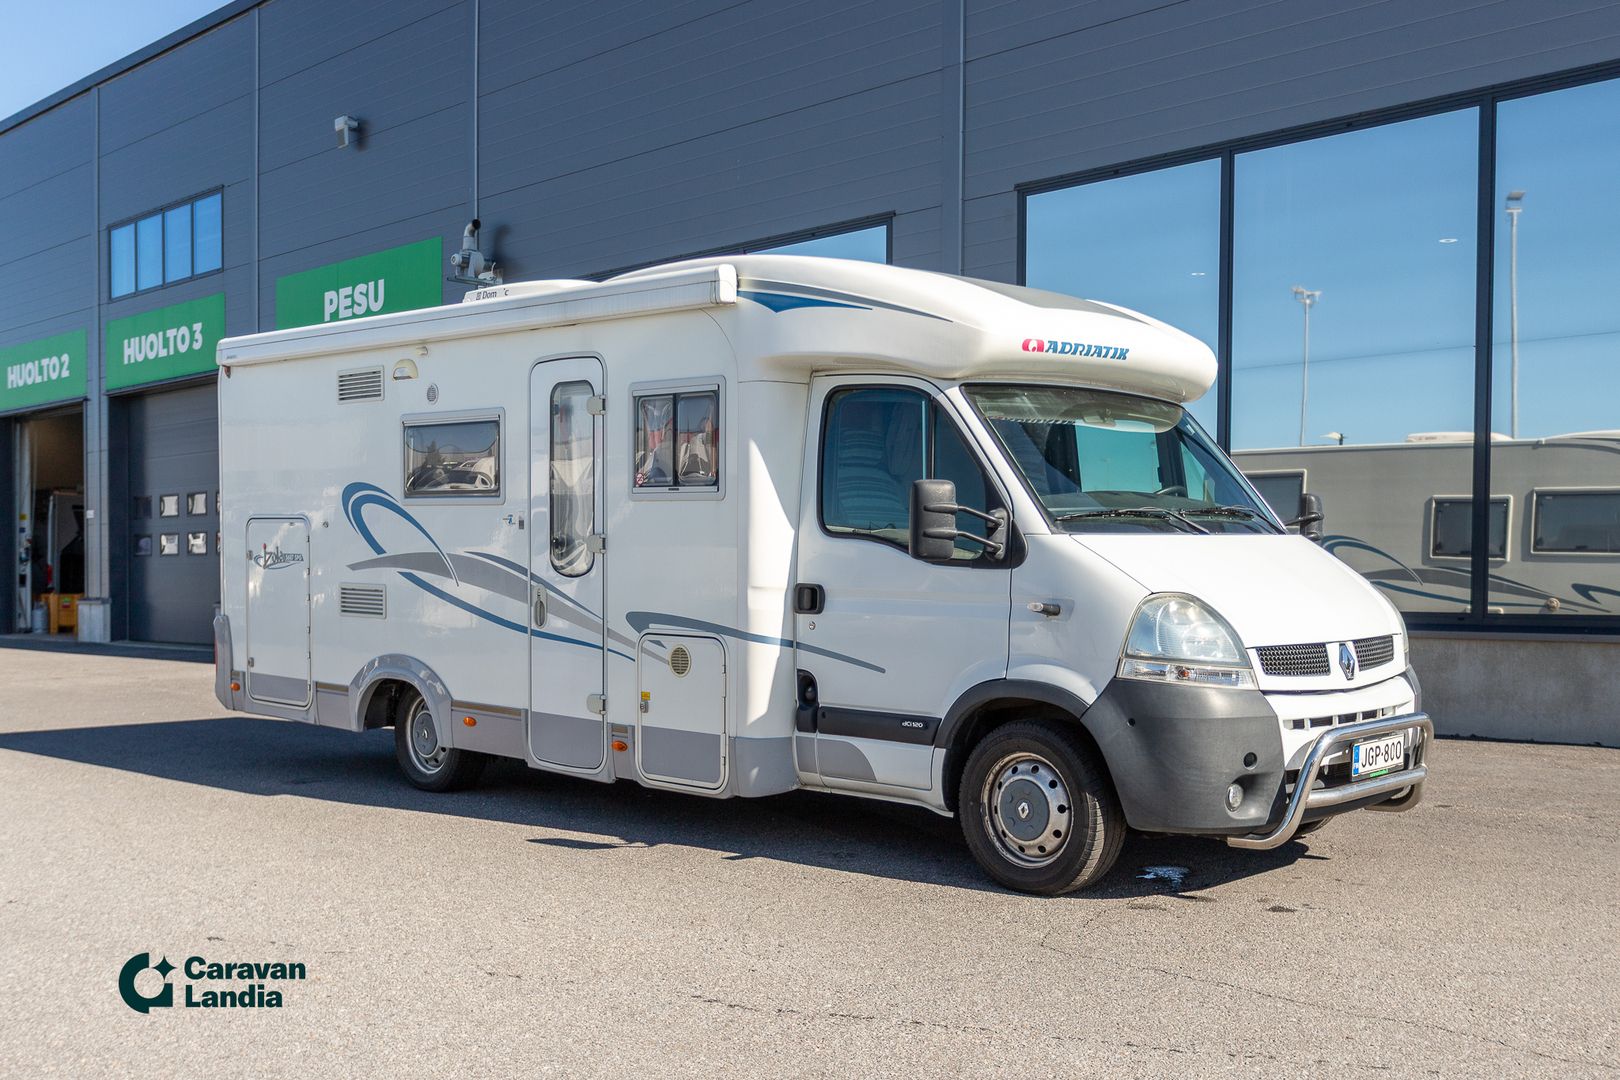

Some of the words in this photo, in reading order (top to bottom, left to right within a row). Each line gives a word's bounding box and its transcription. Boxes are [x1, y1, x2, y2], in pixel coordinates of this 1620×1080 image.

[324, 278, 385, 322] PESU
[123, 326, 190, 365] HUOLTO
[192, 322, 203, 350] 3
[1044, 340, 1130, 361] ADRIATIK
[7, 356, 61, 389] HUOLTO
[60, 353, 70, 378] 2
[1361, 740, 1402, 768] JGP-800
